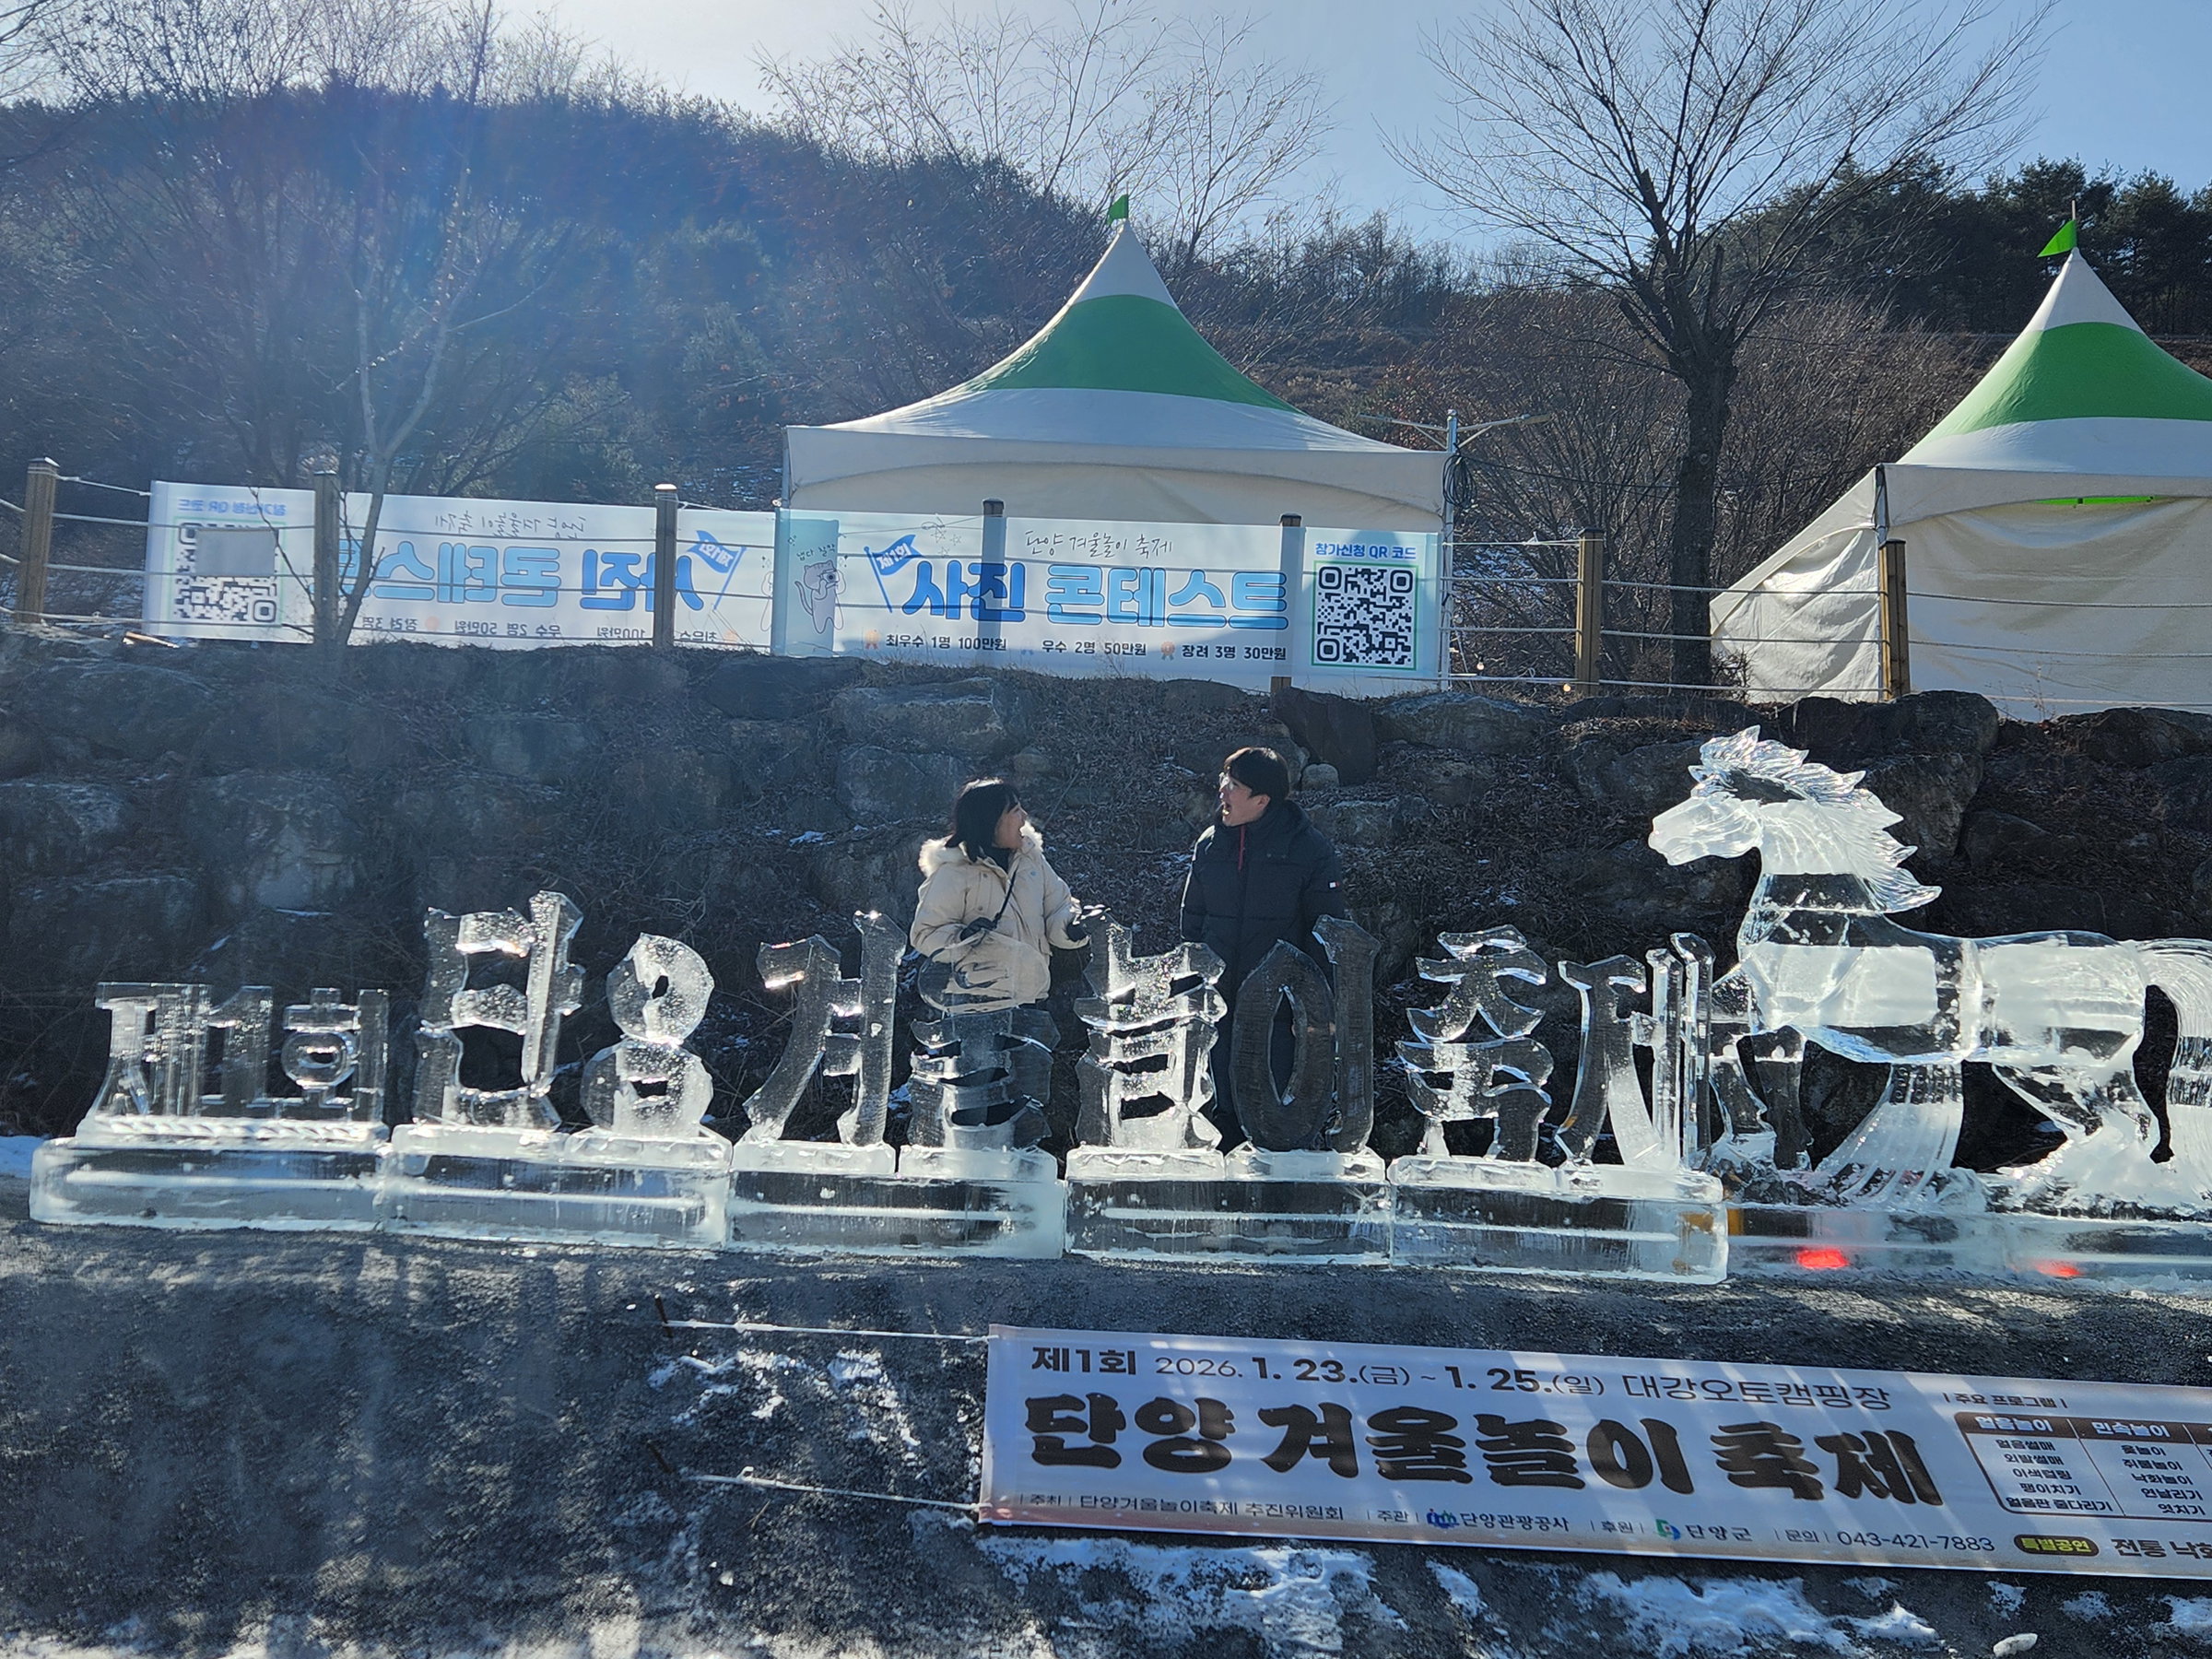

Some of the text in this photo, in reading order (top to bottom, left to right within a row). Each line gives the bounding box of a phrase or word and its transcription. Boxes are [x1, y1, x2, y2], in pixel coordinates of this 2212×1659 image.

[877, 542, 912, 570] 제1회
[1025, 530, 1172, 559] 단양 겨울놀이 축제
[1315, 543, 1417, 559] 참가신청 QR 코드
[901, 559, 1288, 629] 사진 콘테스트
[886, 634, 1007, 652] 최우수 1명 100만원
[1041, 640, 1147, 656] 우수 2명 50만원
[1182, 644, 1287, 660] 장려 3명 30만원
[1031, 1347, 1137, 1375] 제1회
[1154, 1356, 1244, 1378] 2026.
[1621, 1374, 1891, 1411] 대강오토캠핑장
[1955, 1393, 2058, 1408] 주요 프로그램
[1025, 1392, 1945, 1507] 단양 겨울놀이 축제
[1029, 1494, 1344, 1521] 주최 단양겨울놀이축제 추진위원회
[1377, 1509, 1571, 1533] 주관 단양관광공사
[1602, 1519, 1753, 1542] 후원 단양군
[1784, 1529, 1996, 1551] 문의 043-421-7883
[2111, 1538, 2168, 1558] 전통
